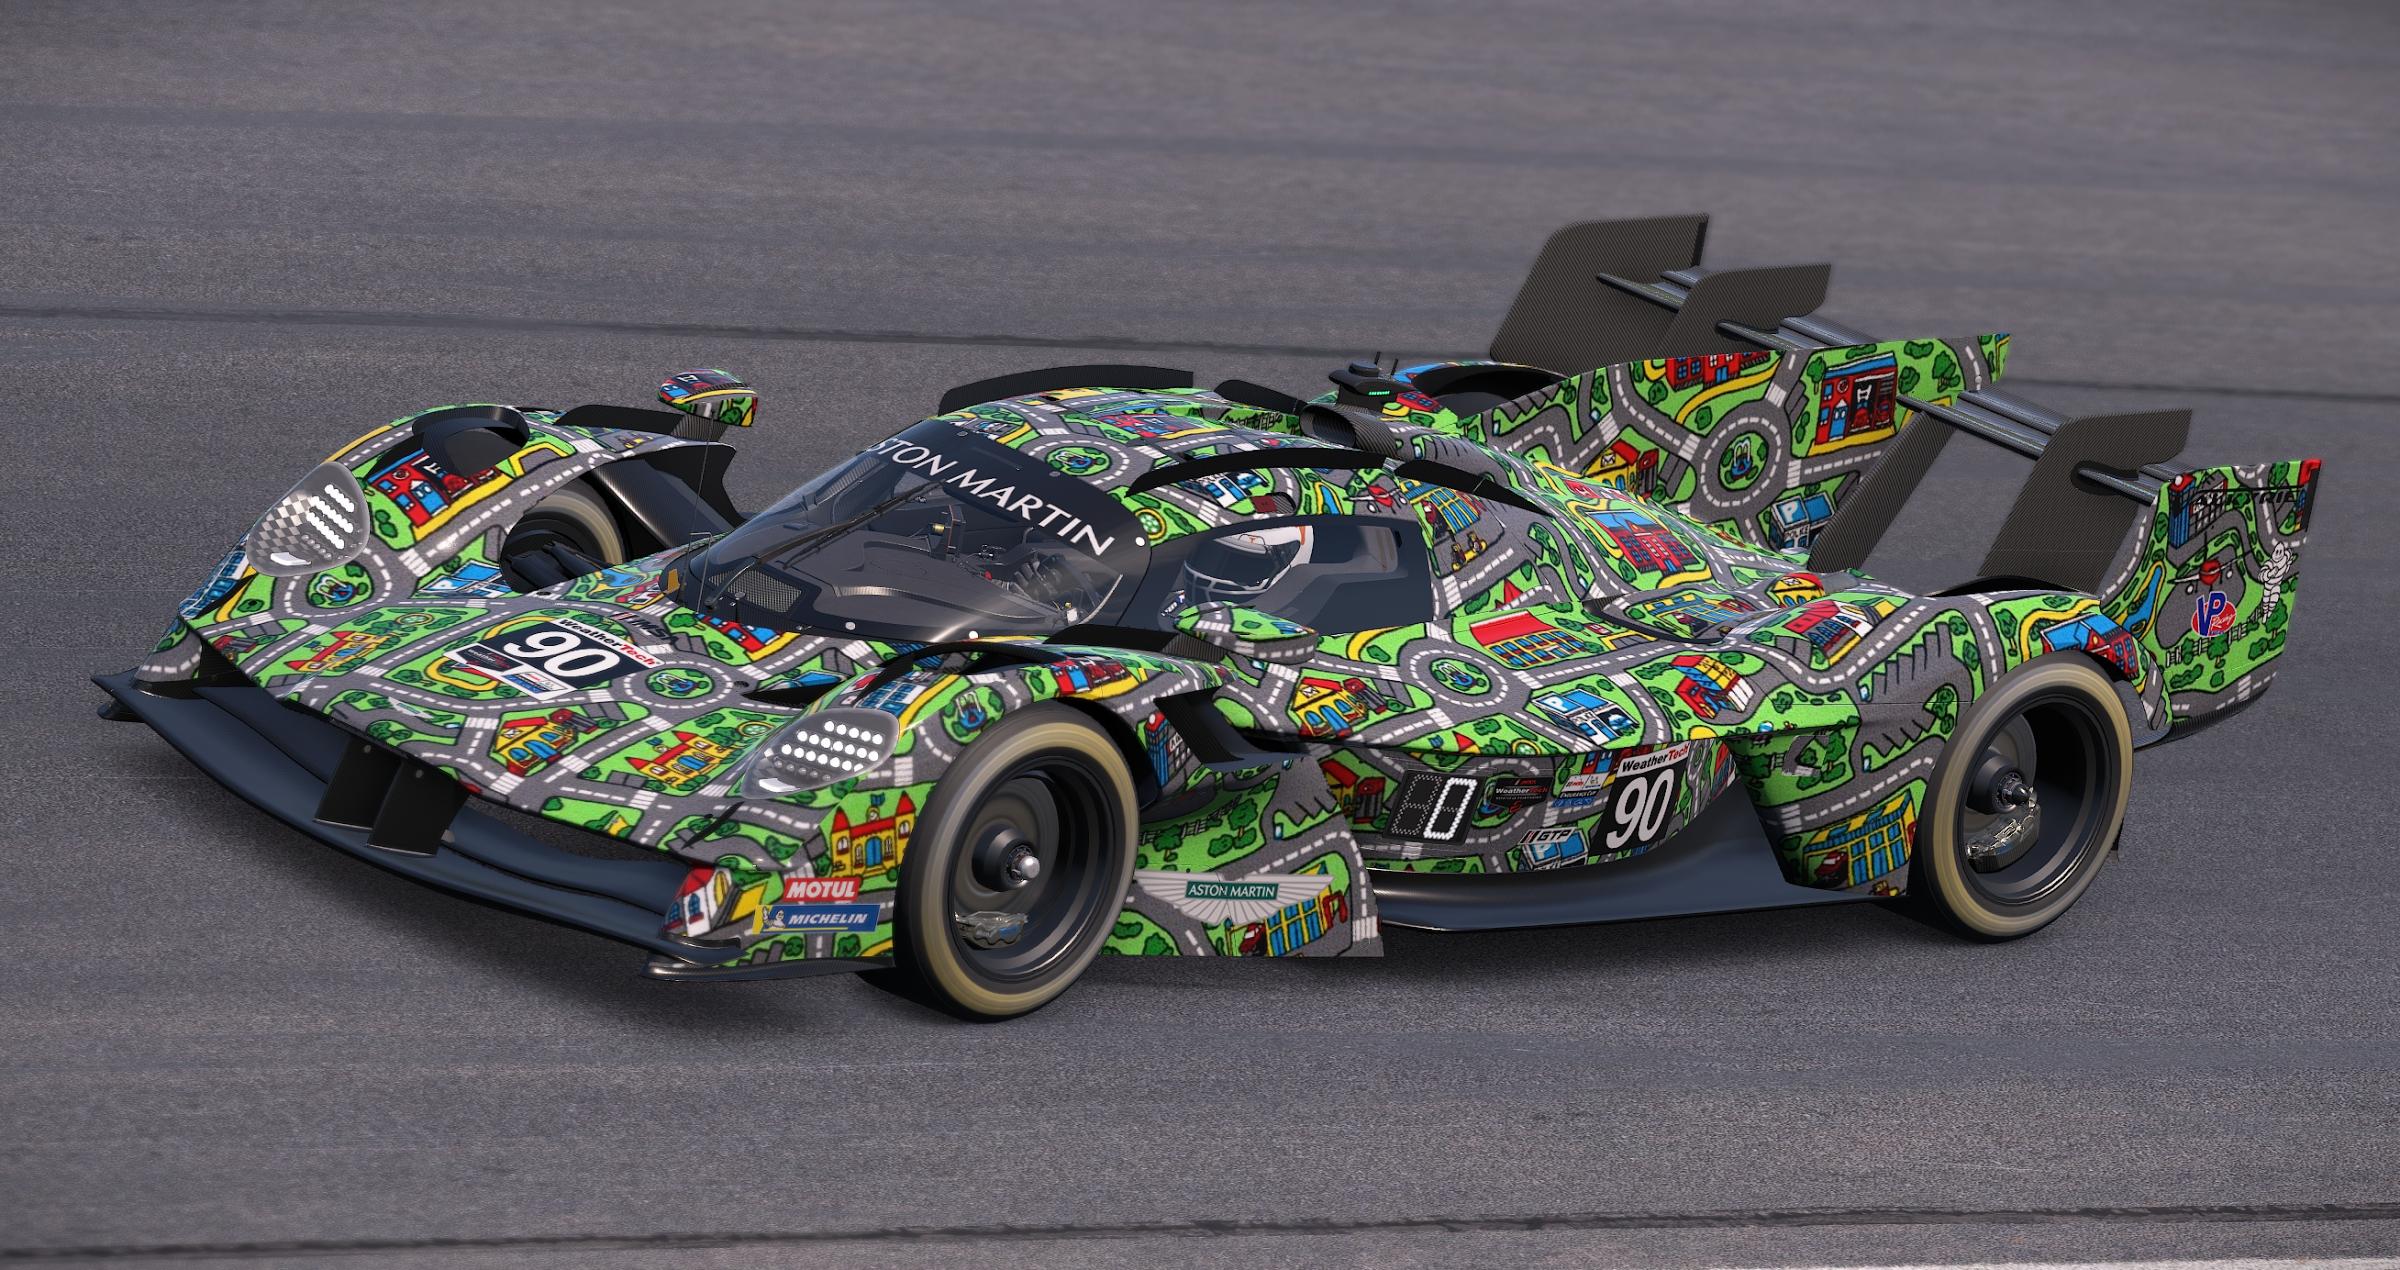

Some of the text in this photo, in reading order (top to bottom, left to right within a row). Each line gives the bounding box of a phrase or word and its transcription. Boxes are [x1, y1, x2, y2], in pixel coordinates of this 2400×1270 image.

[946, 468, 1115, 556] MARTIN
[2196, 591, 2227, 637] VP
[503, 631, 621, 677] 90
[559, 617, 657, 666] WeatherTech
[1622, 743, 1690, 773] WeatherTech
[1606, 768, 1676, 849] 90
[1537, 829, 1571, 842] GTP
[786, 881, 856, 898] MOTUL
[1188, 884, 1275, 898] ASTON MARTIN
[788, 913, 868, 925] MICHELIN
